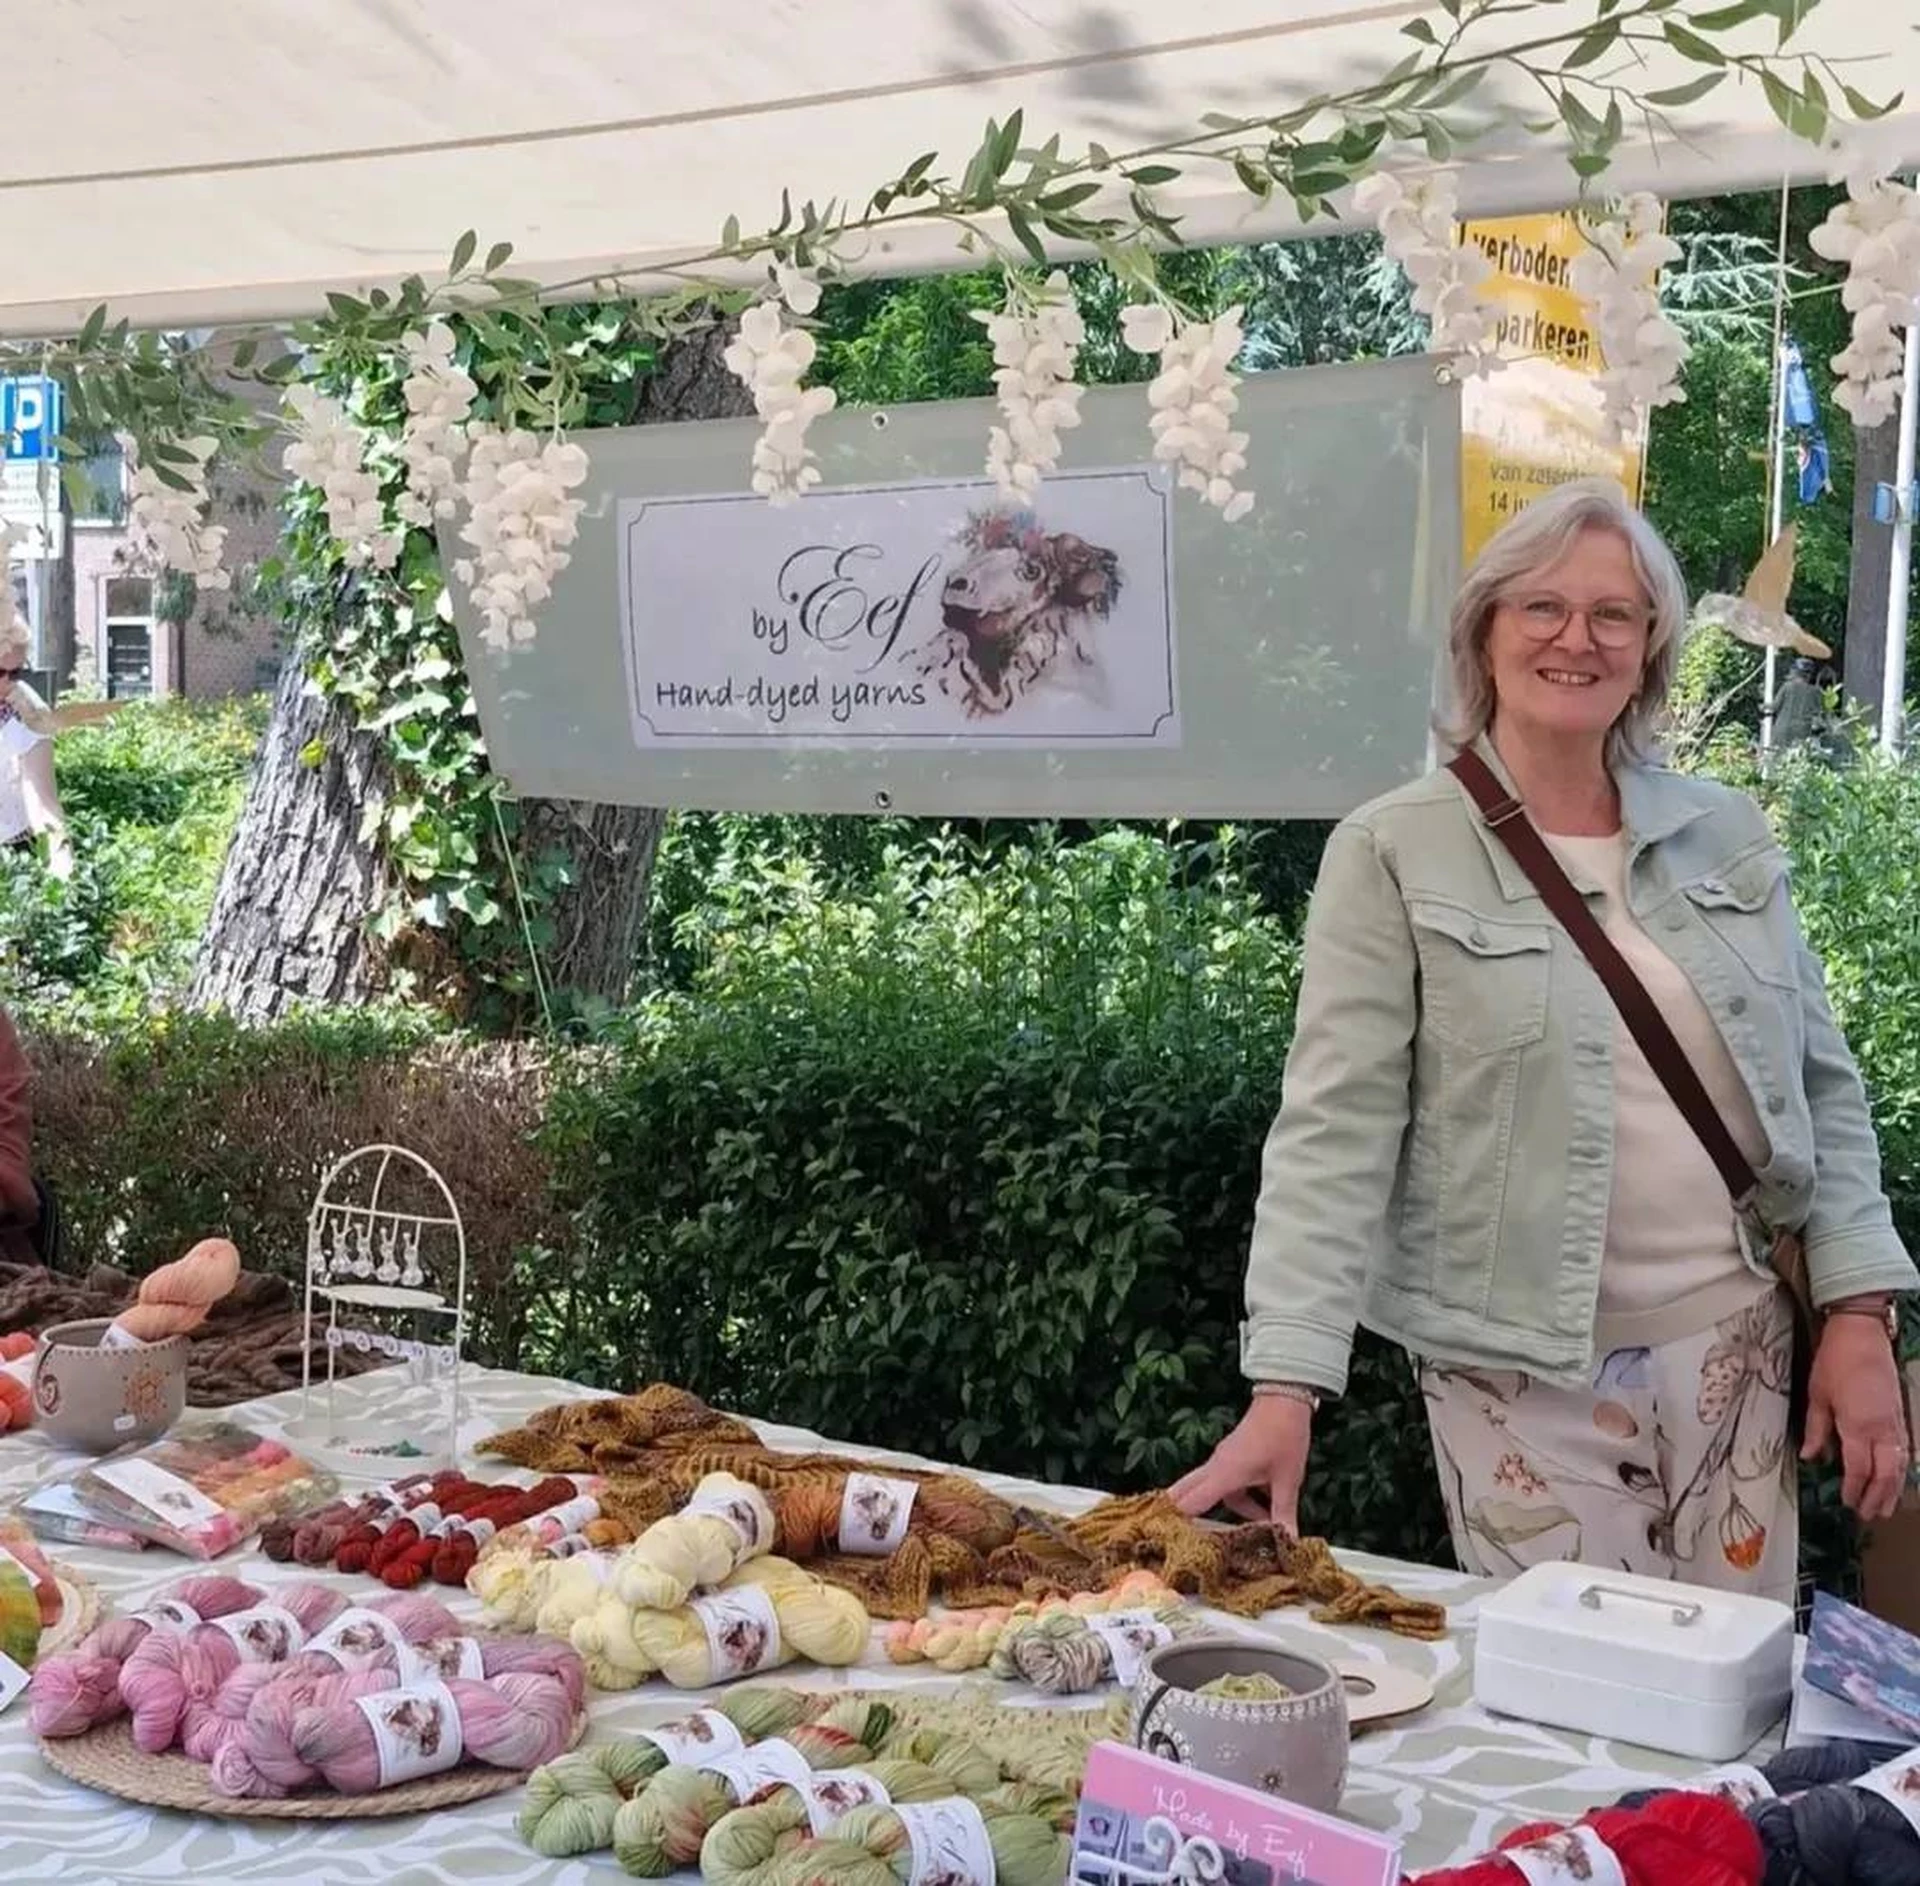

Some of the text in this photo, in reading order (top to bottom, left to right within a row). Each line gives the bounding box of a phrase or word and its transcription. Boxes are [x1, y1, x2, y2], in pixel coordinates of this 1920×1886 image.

[1495, 309, 1590, 361] parkeren
[1490, 491, 1509, 513] 14
[752, 543, 941, 675] by Eef
[656, 677, 926, 723] Hand-dyed yarns
